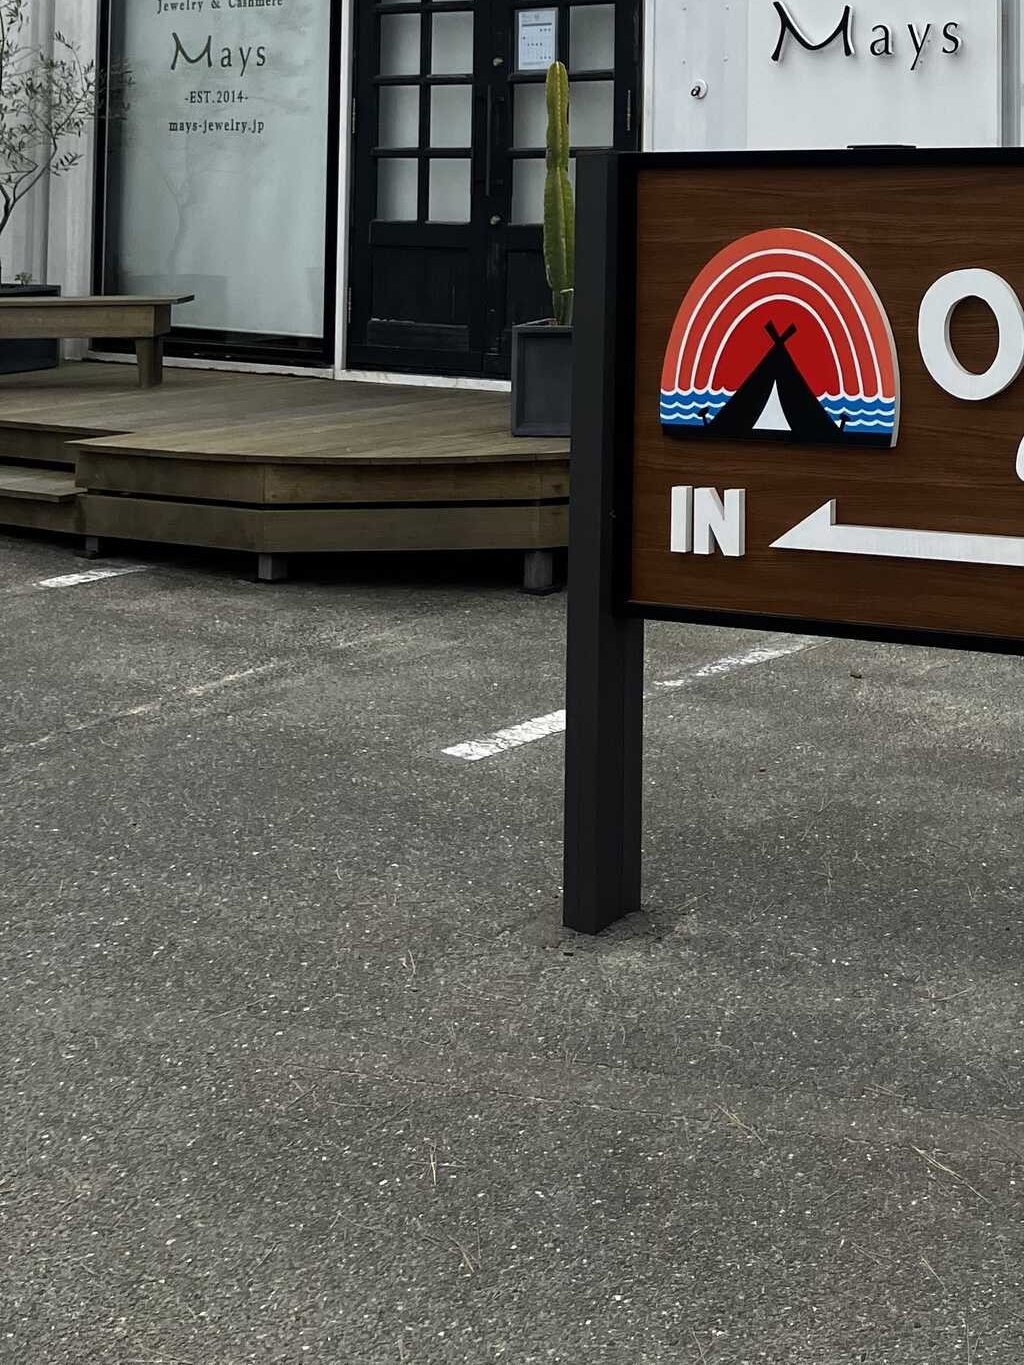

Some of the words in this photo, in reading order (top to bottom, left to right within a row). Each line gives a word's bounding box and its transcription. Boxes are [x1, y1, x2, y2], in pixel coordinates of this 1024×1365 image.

[170, 32, 266, 76] Mays
[771, 0, 964, 71] Mays
[168, 118, 265, 134] mays-jewelry.jp
[670, 485, 746, 557] IN
